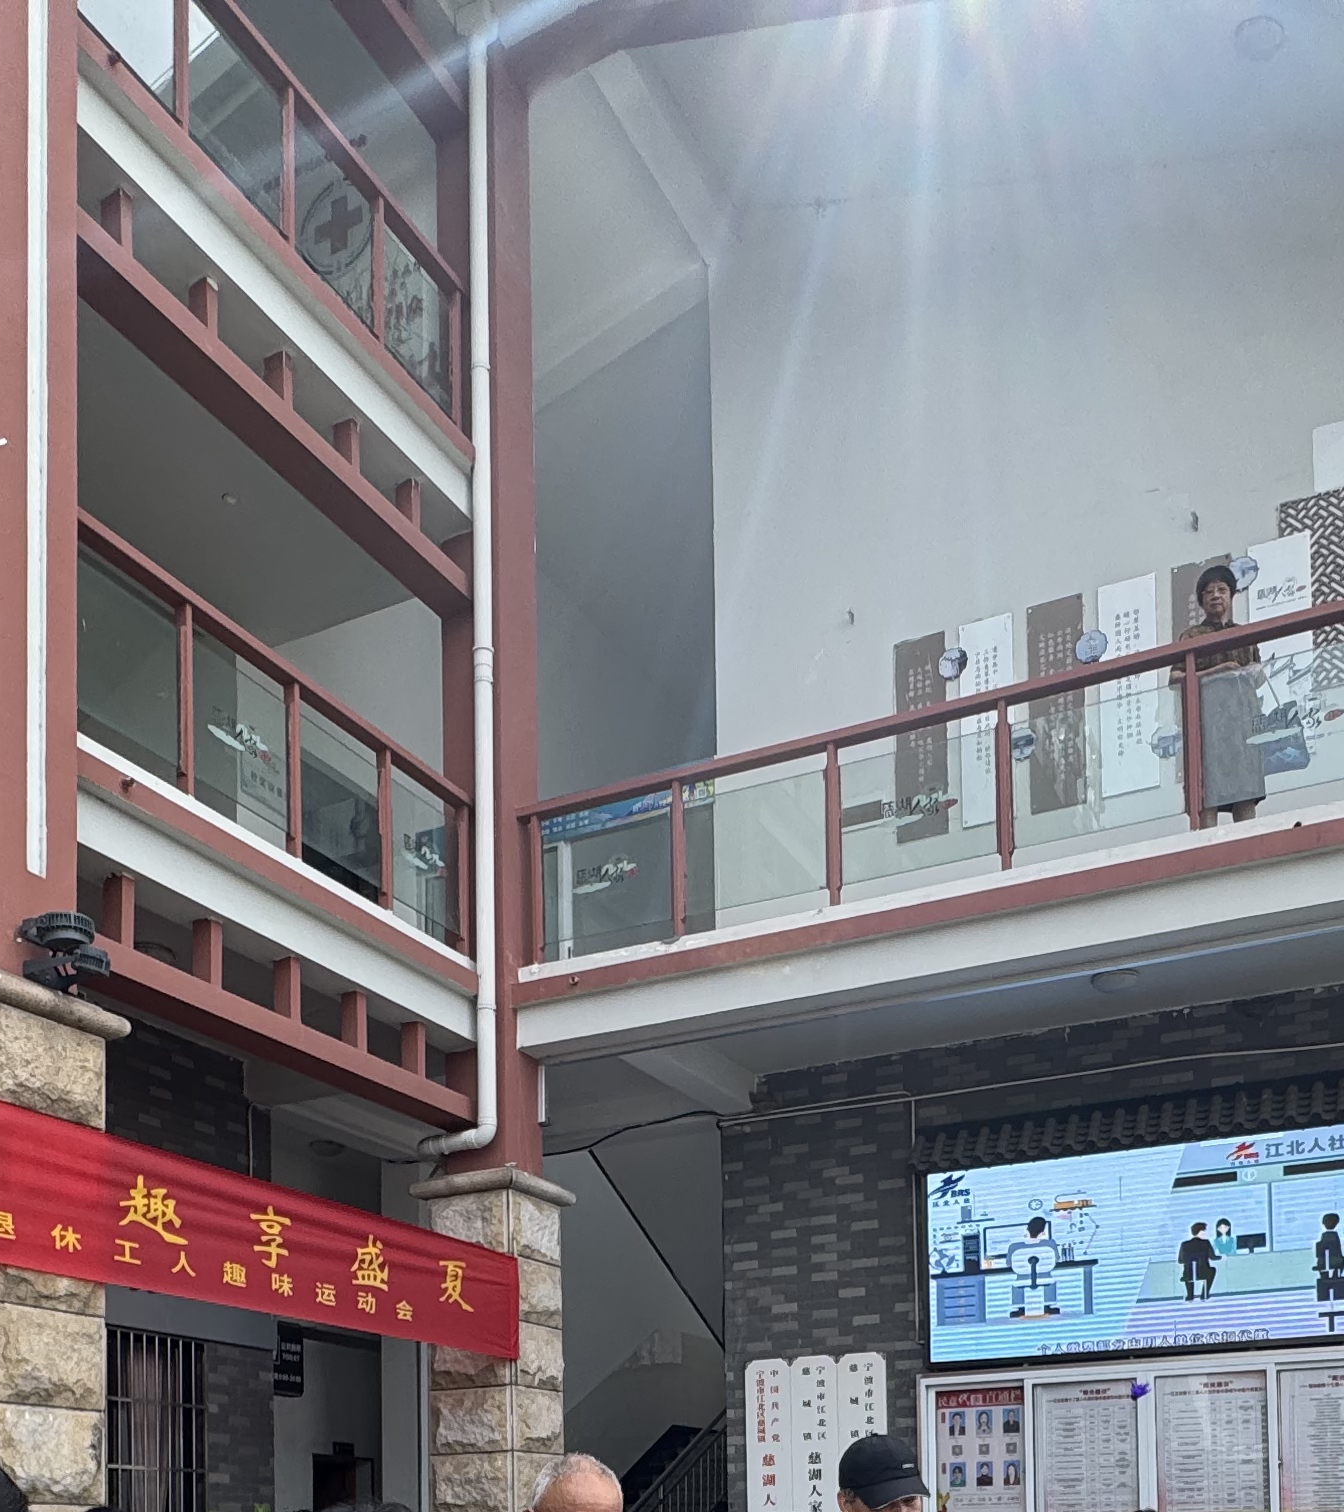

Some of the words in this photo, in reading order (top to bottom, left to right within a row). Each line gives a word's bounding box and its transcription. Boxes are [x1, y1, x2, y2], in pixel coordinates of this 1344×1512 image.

[119, 1175, 474, 1312] 趣享盛夏
[755, 1370, 766, 1443] 宁波市江北区慈城镇
[769, 1369, 780, 1443] 中国共产党
[801, 1366, 812, 1441] 慈城镇
[816, 1366, 827, 1441] 宁波市江北区
[849, 1363, 859, 1439] 慈城镇
[762, 1453, 777, 1507] 慈湖人
